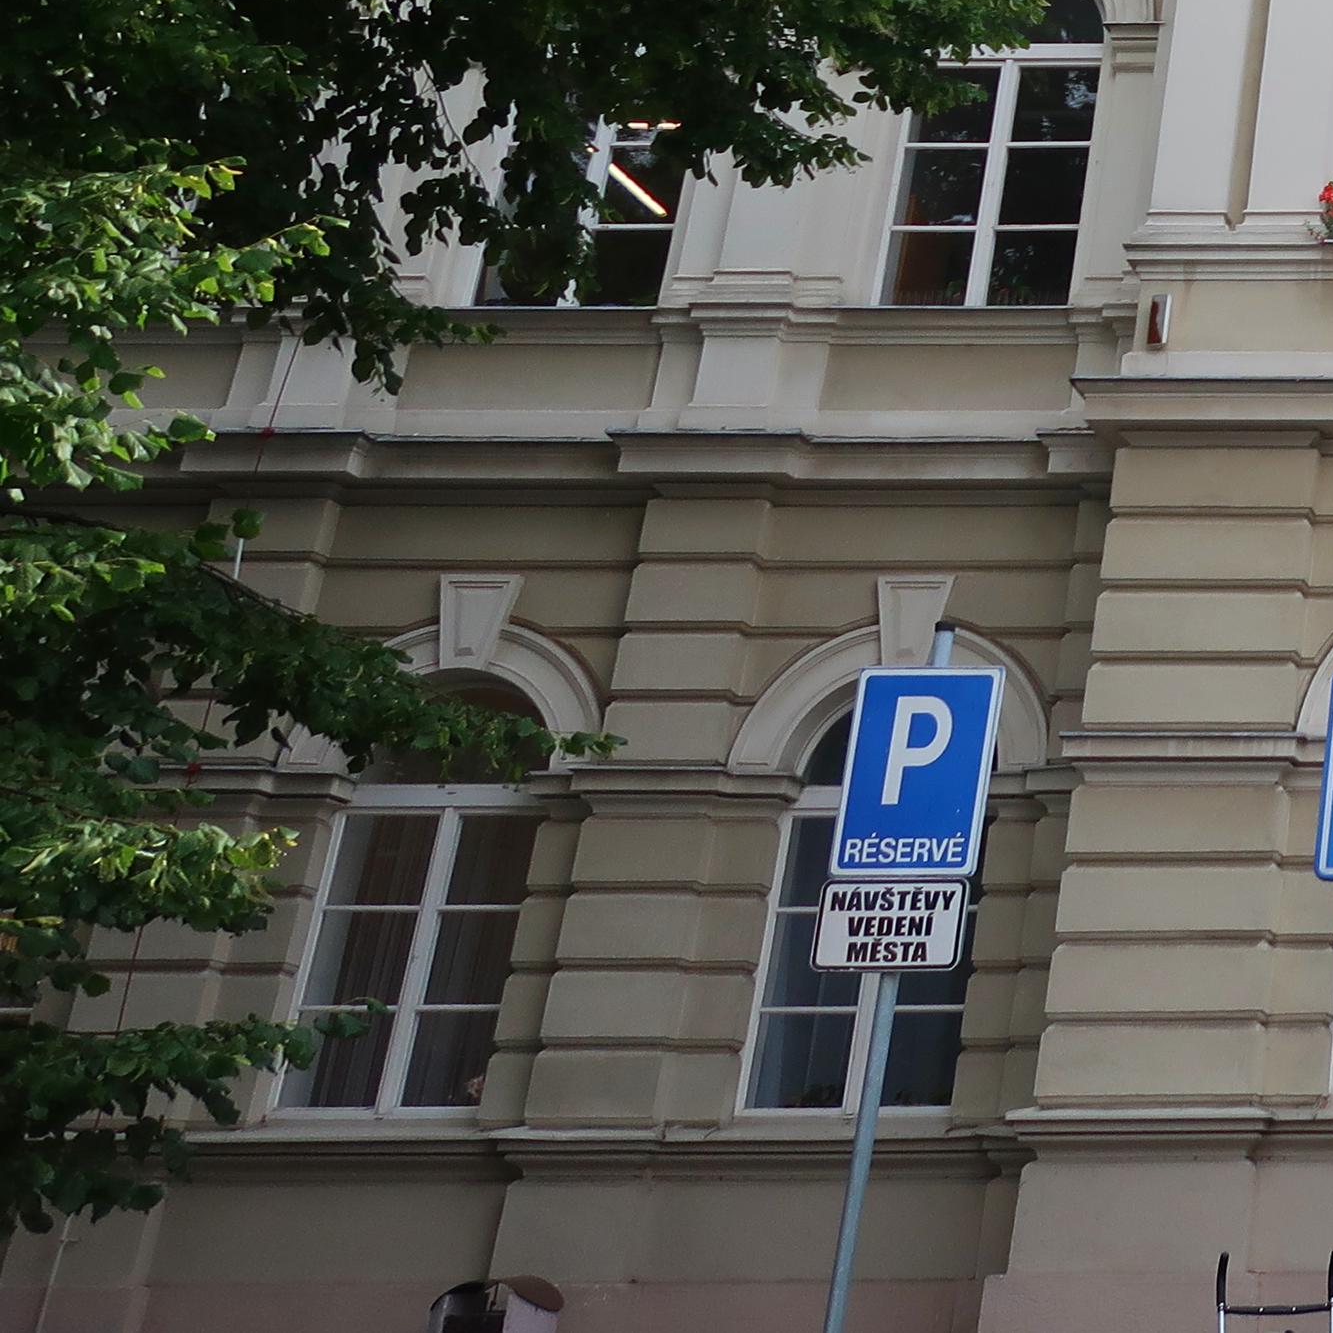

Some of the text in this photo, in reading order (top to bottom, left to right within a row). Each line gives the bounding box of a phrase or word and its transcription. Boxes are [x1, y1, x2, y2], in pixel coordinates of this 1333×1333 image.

[880, 694, 953, 806] P
[843, 832, 966, 863] RÉSERVÉ
[830, 886, 958, 912] NÁVŠTĚVY
[847, 912, 935, 937] VEDENÍ
[846, 938, 928, 963] MĚSTA
